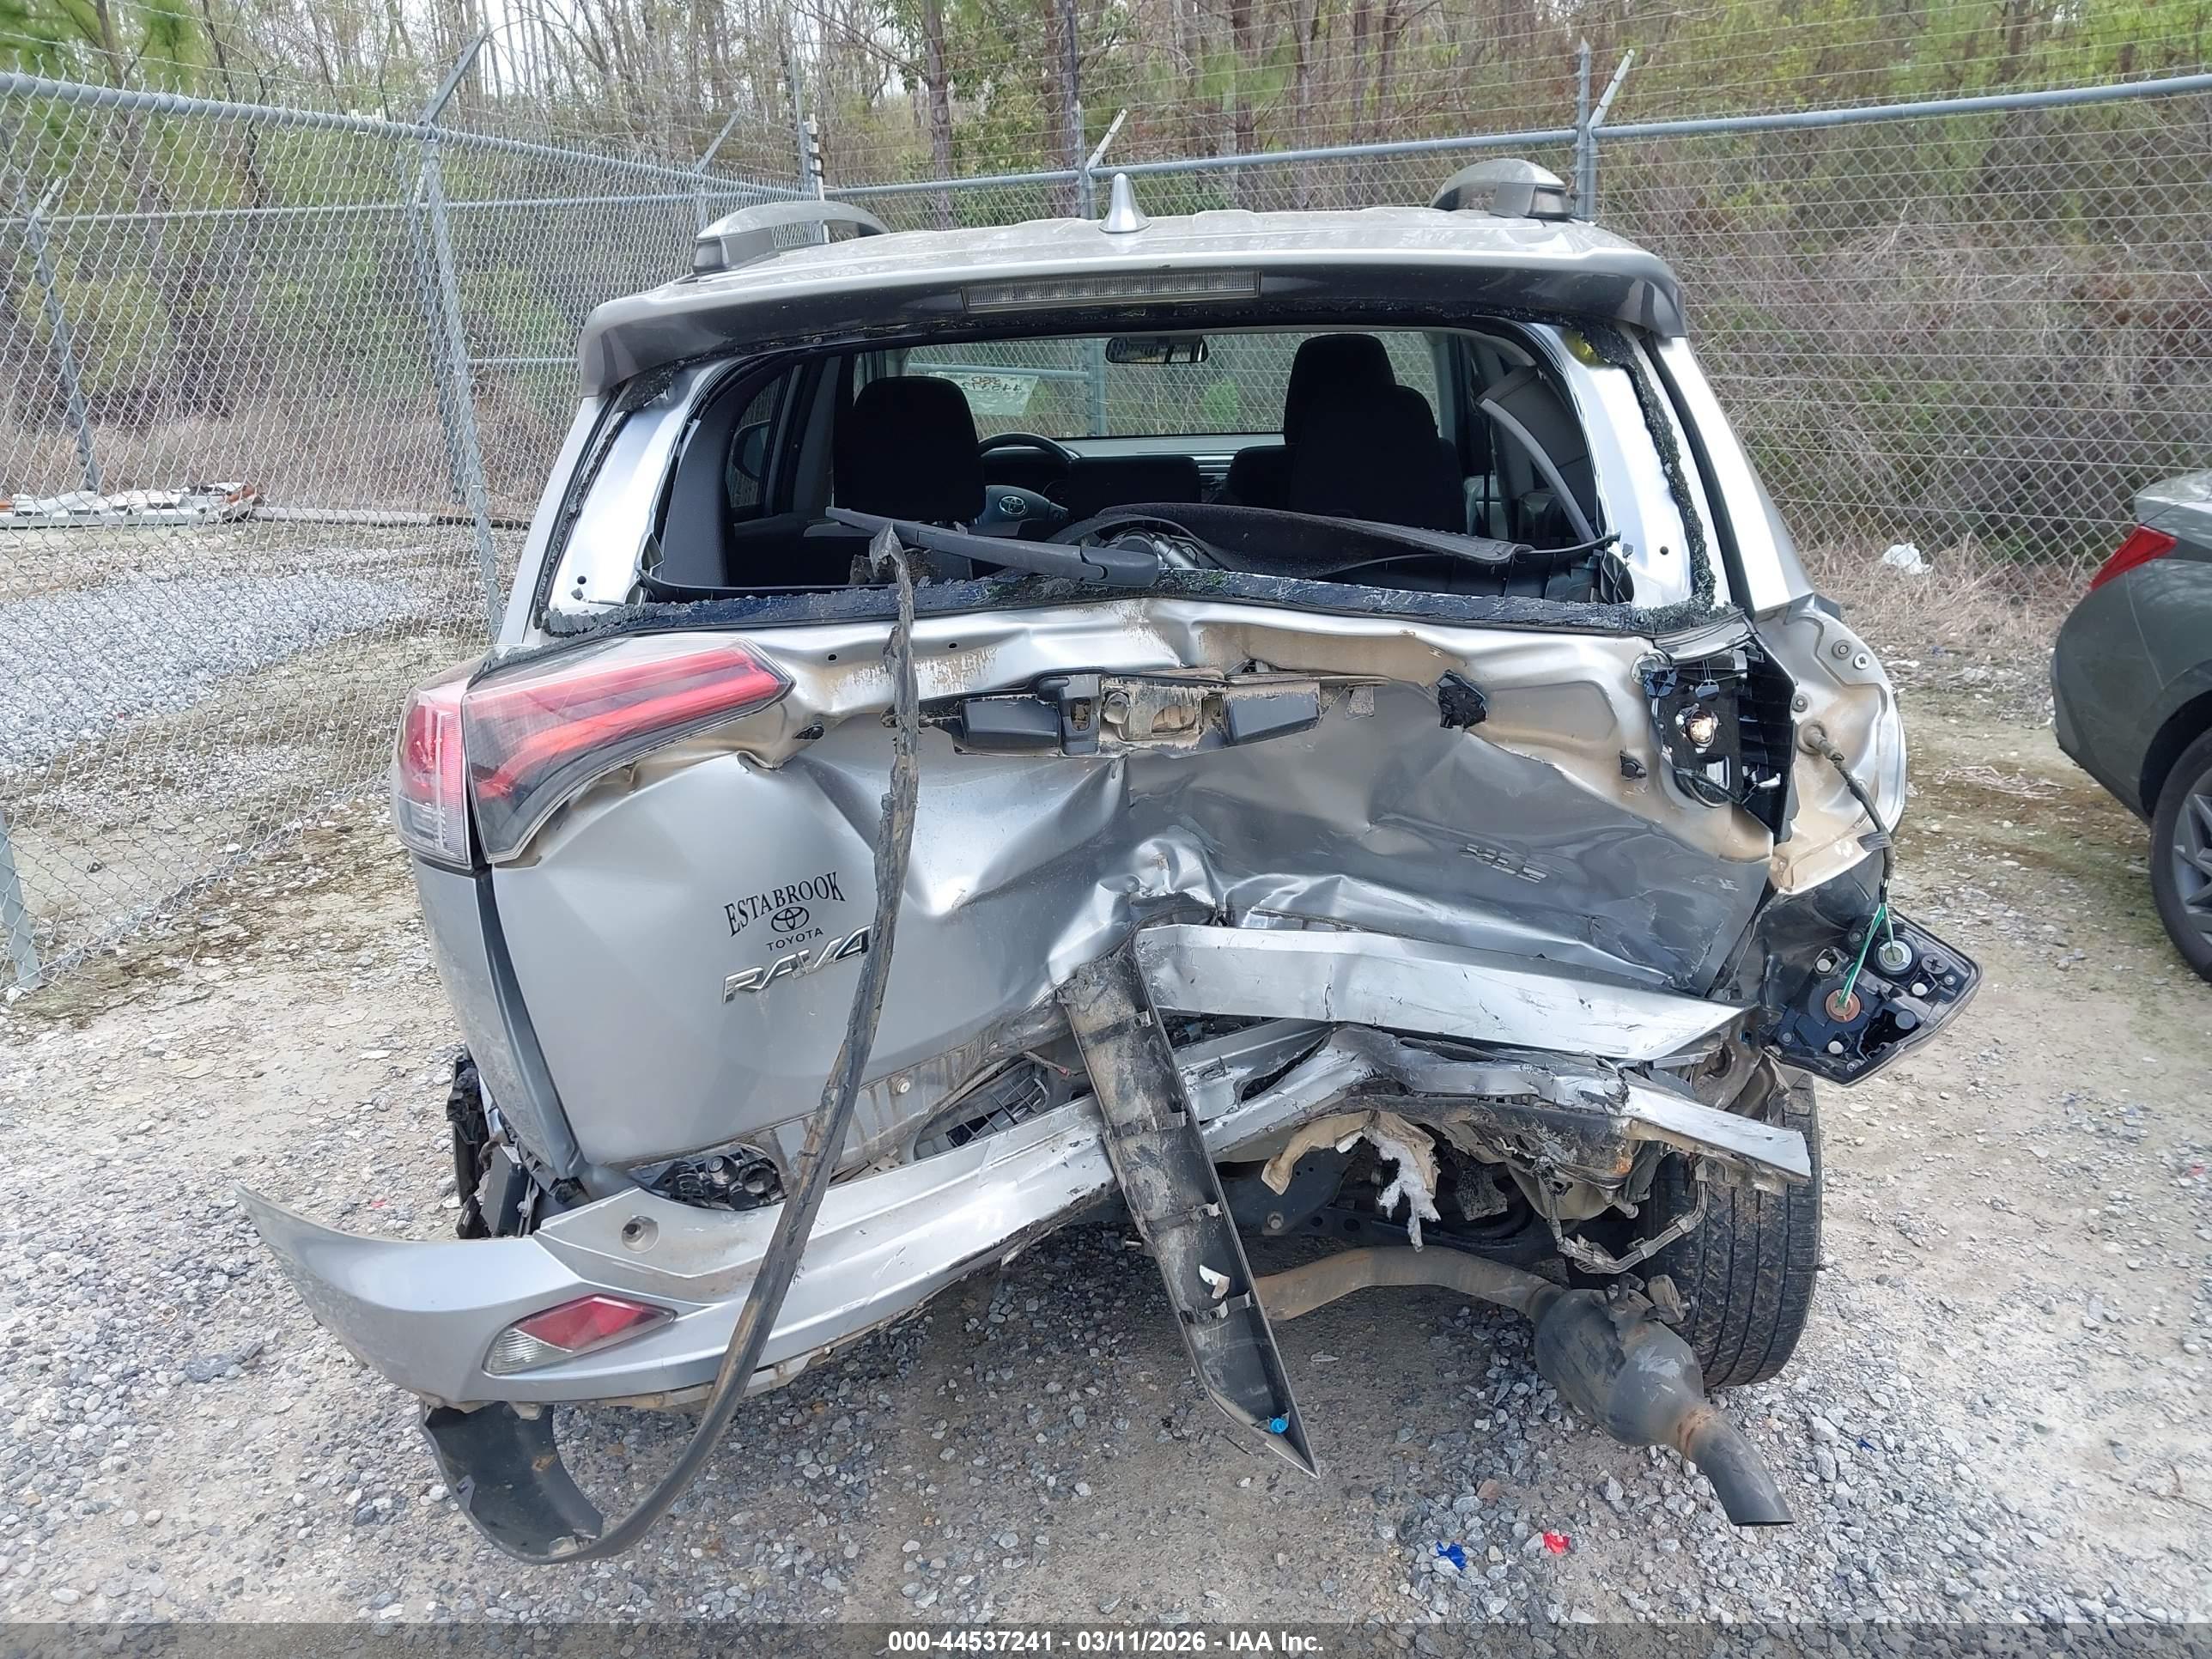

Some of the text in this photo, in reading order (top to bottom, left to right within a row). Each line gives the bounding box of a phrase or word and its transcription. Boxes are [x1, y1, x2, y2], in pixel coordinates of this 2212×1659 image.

[724, 872, 846, 937] ESTABROOK
[722, 925, 872, 1004] RAV4
[766, 927, 824, 951] TOYOTA
